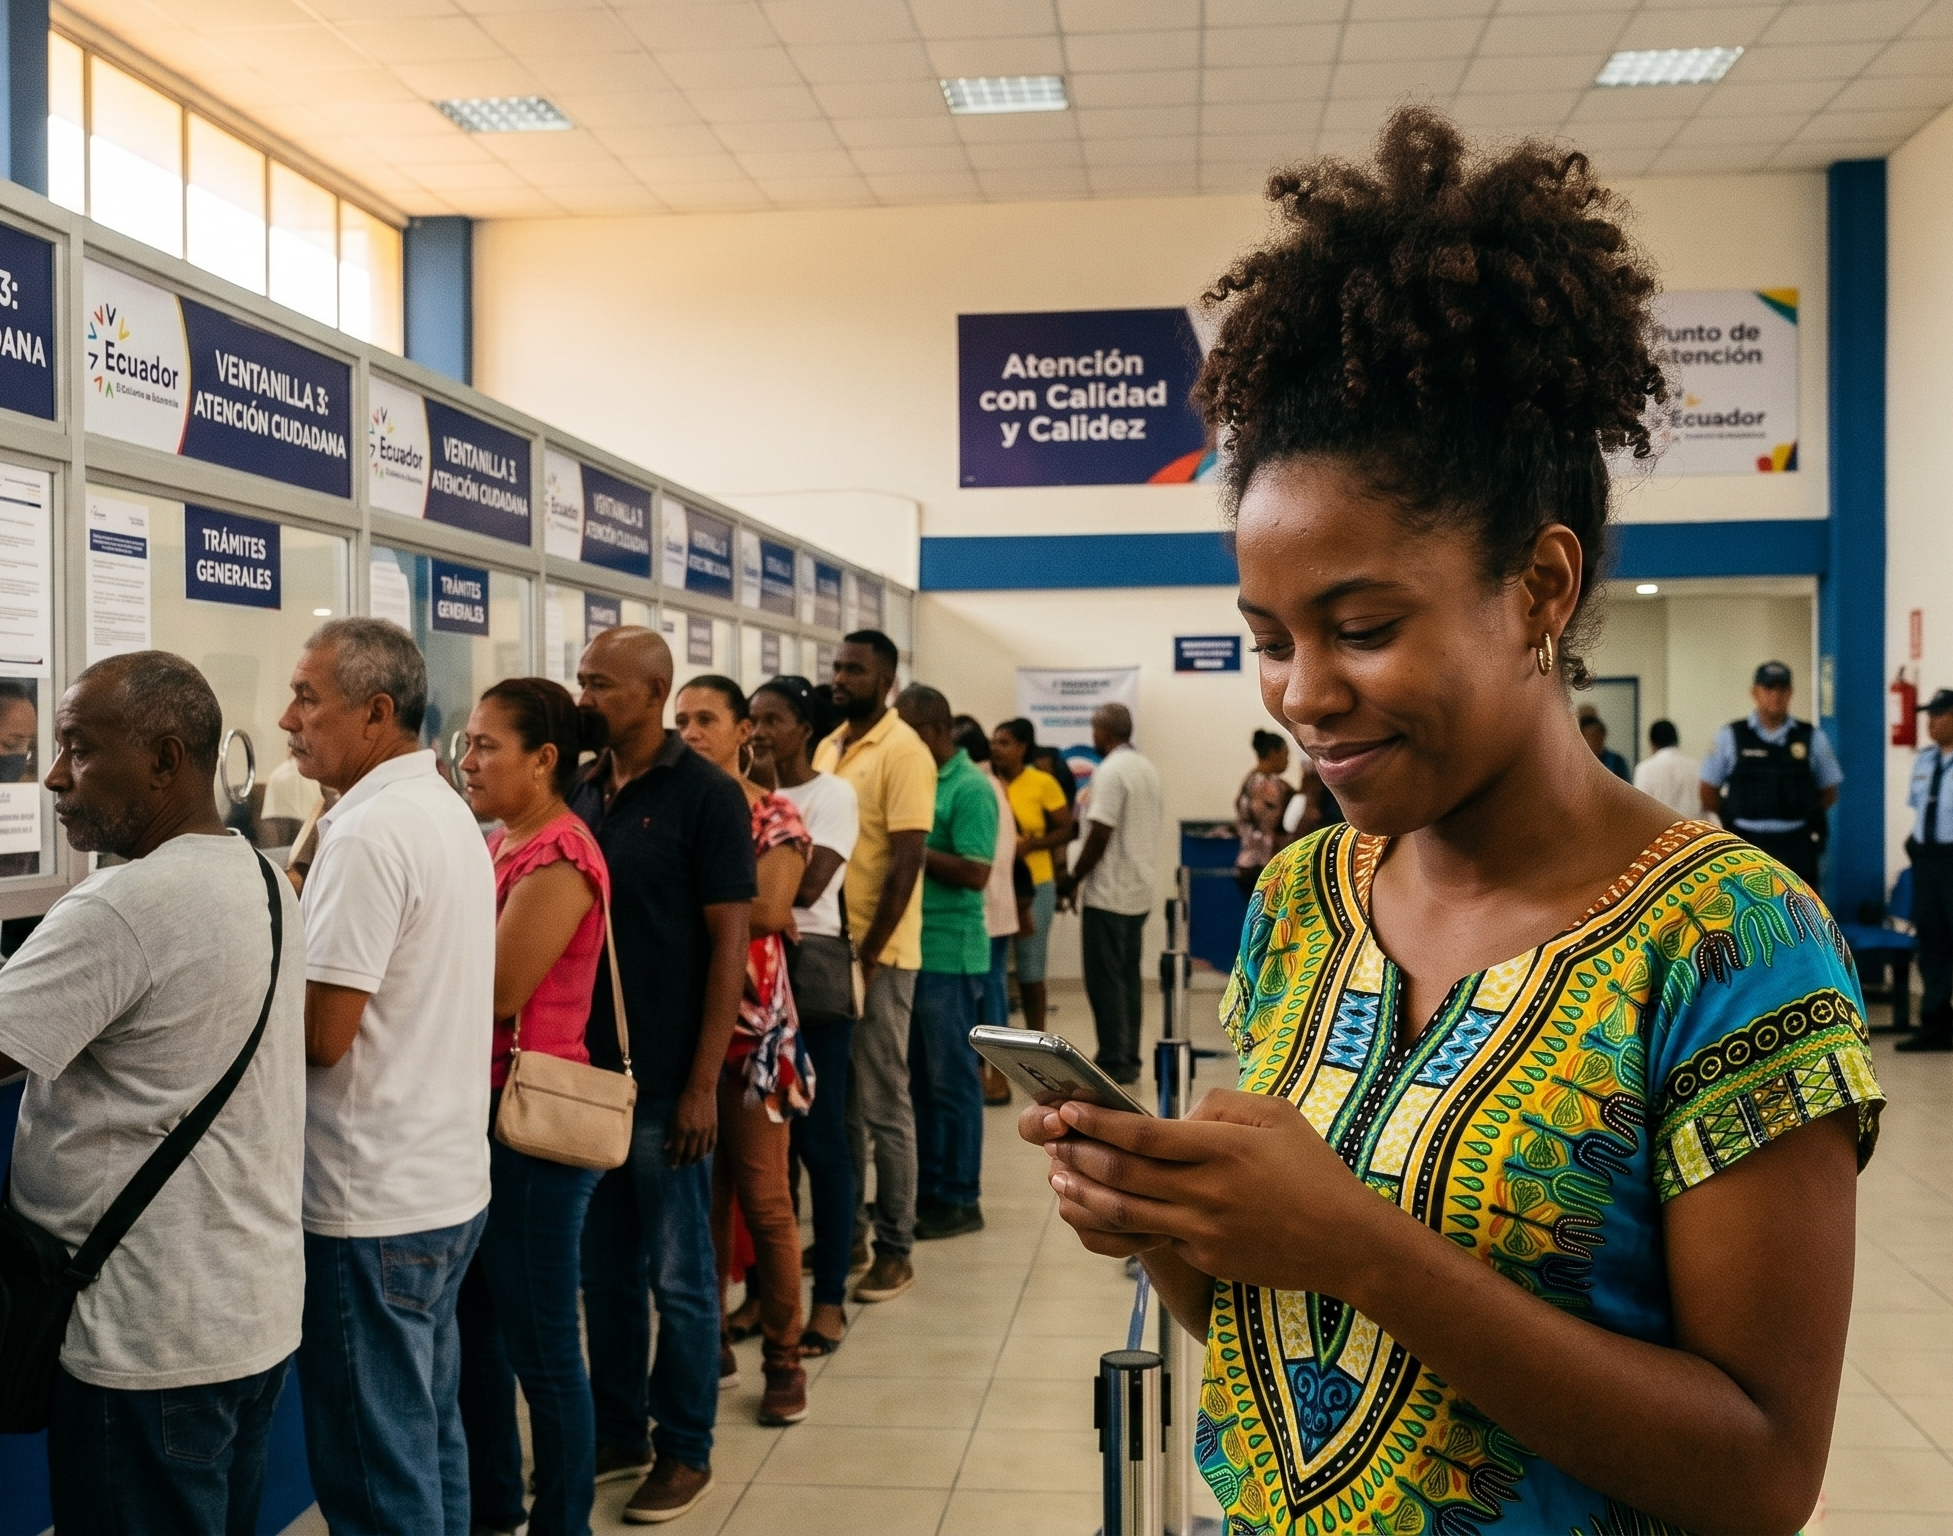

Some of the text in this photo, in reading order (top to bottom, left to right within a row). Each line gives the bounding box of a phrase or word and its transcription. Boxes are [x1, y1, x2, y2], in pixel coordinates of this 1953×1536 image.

[0, 269, 18, 310] 3:
[0, 326, 46, 368] ANA
[1729, 324, 1760, 342] de
[105, 340, 178, 390] Ecuador
[1001, 349, 1144, 380] Atención
[1663, 345, 1763, 365] tención
[215, 349, 314, 412] VENTANILLA
[316, 386, 329, 416] 3:
[979, 380, 1168, 412] con Calidad
[194, 391, 269, 437] ATENCIÓN
[271, 415, 347, 460] CIUDADANA
[1000, 414, 1146, 448] y Calidez
[380, 436, 423, 470] Ecuador
[443, 435, 508, 481] VENTANILLA
[202, 526, 266, 560] TRÁMITES
[196, 558, 272, 591] GENERALES
